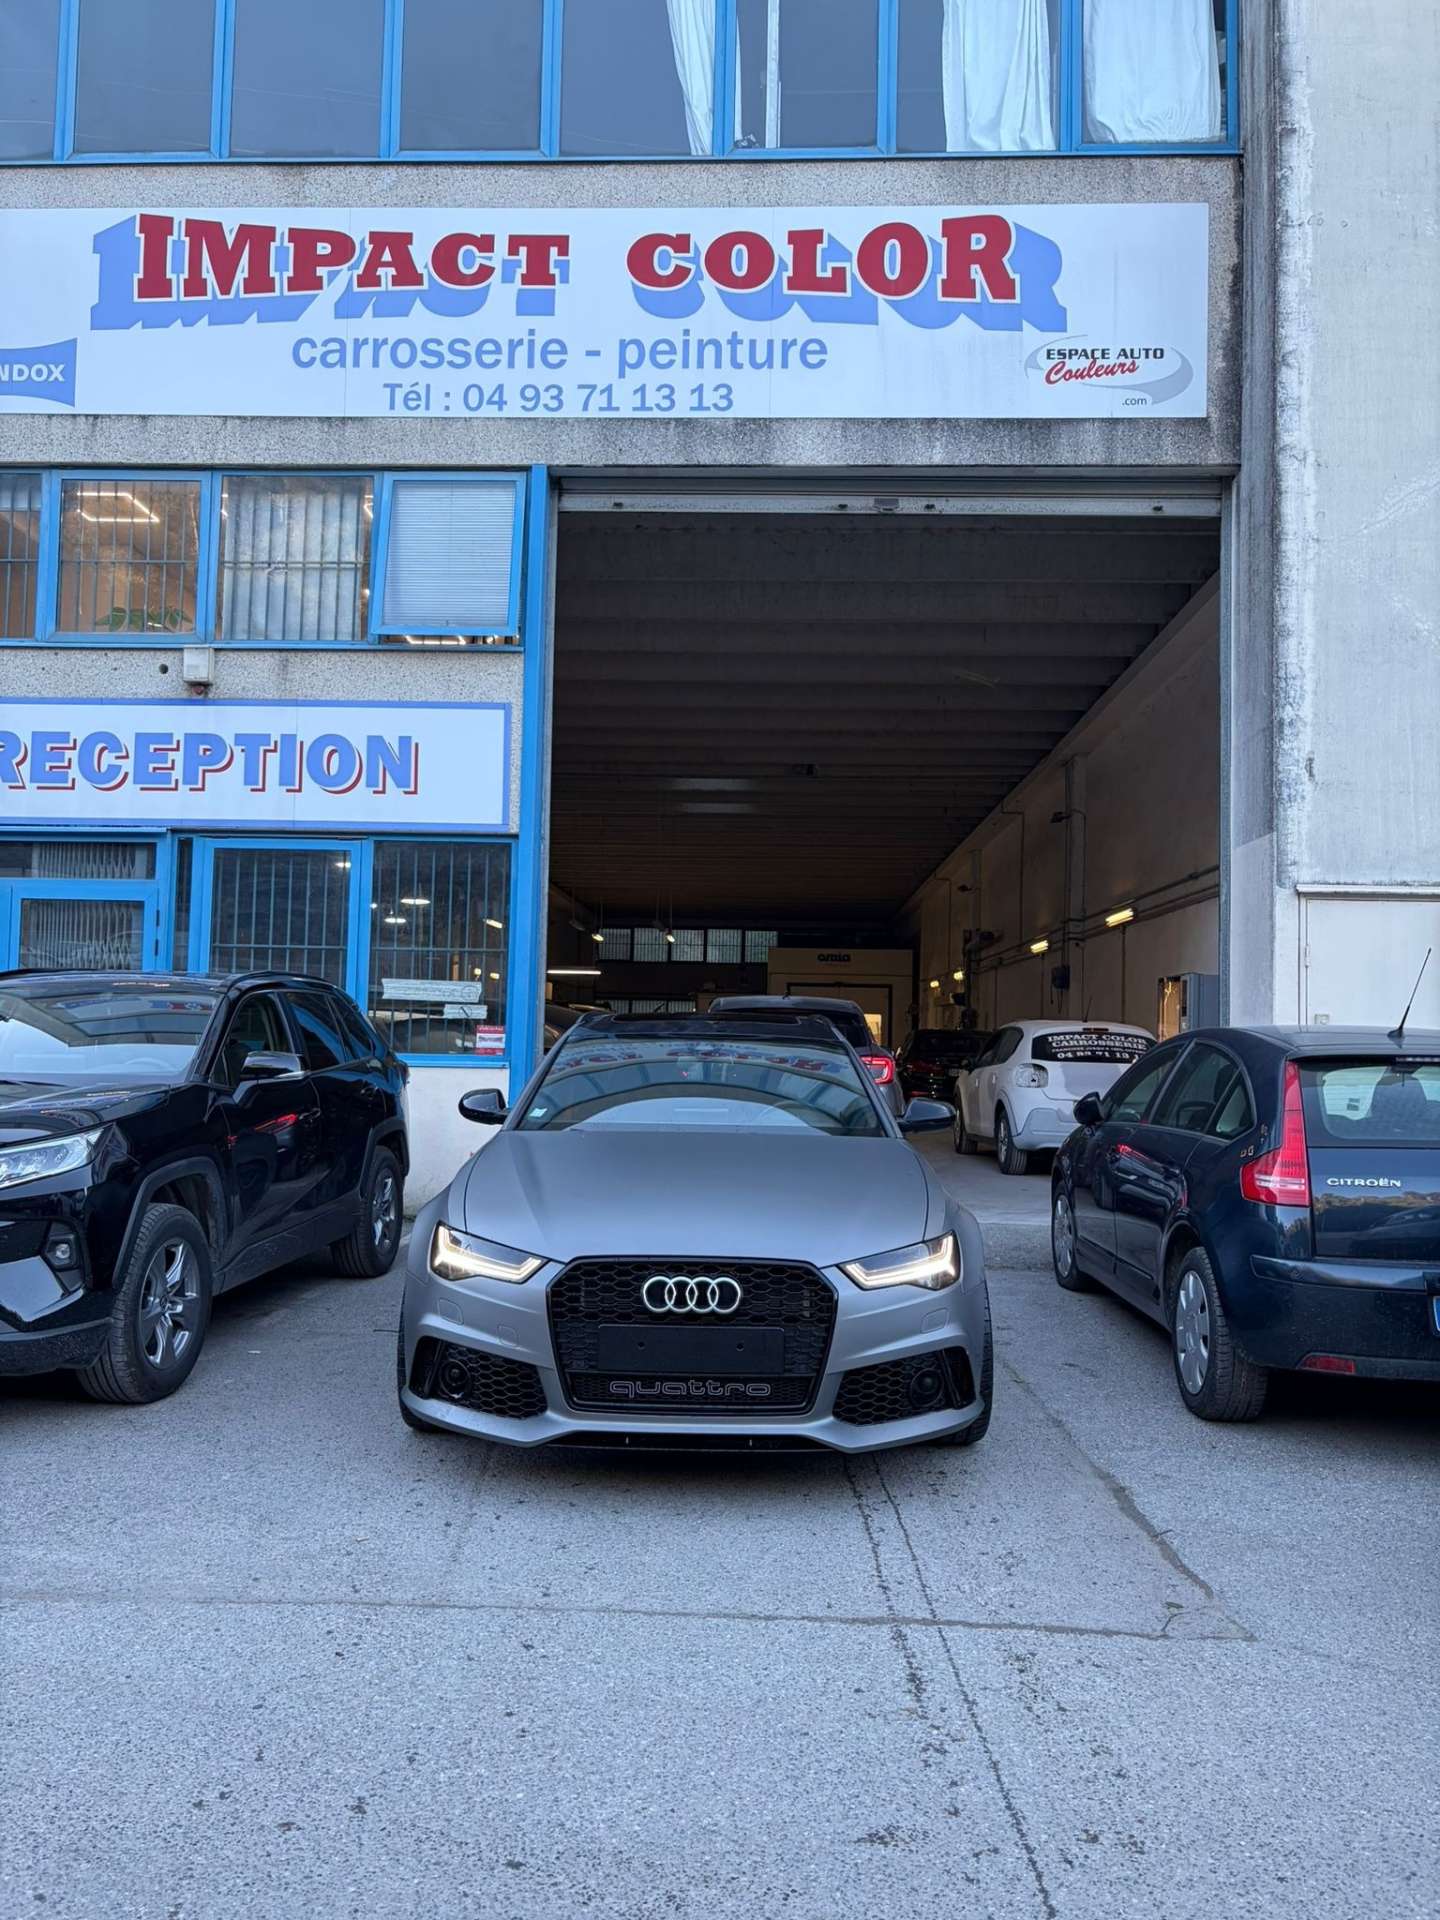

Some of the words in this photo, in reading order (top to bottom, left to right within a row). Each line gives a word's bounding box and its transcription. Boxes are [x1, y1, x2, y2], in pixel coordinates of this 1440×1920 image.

[133, 212, 571, 300] IMPACT
[626, 213, 1019, 302] COLOR
[291, 328, 569, 370] carrosserie
[585, 349, 601, 357] -
[618, 328, 828, 379] peinture
[1045, 348, 1111, 360] ESPACE
[1116, 347, 1165, 360] AUTO
[1044, 358, 1139, 385] Couleurs
[383, 381, 431, 412] Tél
[463, 383, 508, 412] 04
[519, 383, 565, 412] 93
[577, 383, 620, 412] 71
[632, 383, 676, 412] 13
[689, 383, 734, 412] 13
[1121, 397, 1148, 406] .com
[0, 730, 420, 795] RECEPTION
[1048, 1034, 1099, 1042] IMPACT
[1102, 1034, 1148, 1045] COLOR
[1051, 1040, 1147, 1051] CARROSSERIE
[609, 1379, 771, 1399] quattro
